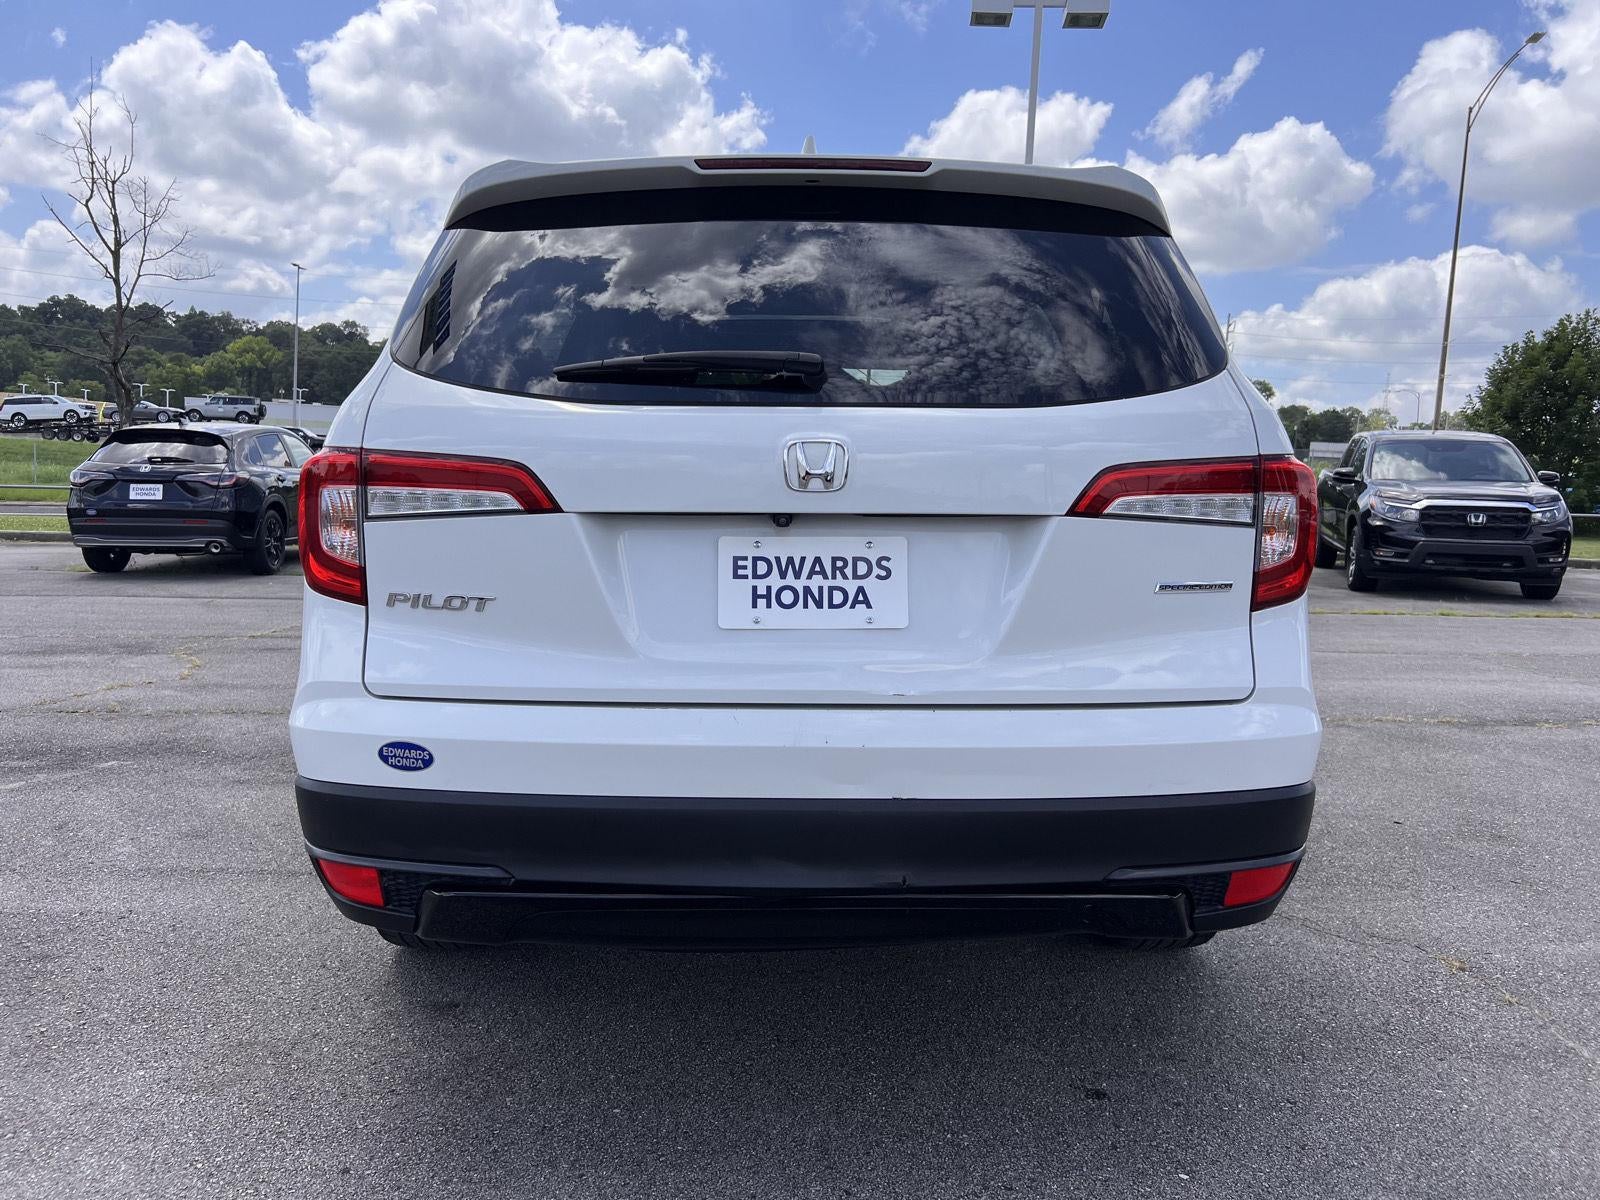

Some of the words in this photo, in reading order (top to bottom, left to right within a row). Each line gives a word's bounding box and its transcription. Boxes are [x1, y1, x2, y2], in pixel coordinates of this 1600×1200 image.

[732, 556, 892, 580] EDWARDS
[1199, 583, 1233, 591] EDITION
[386, 593, 497, 612] PILOT
[751, 585, 872, 609] HONDA
[383, 747, 429, 760] EDWARDS
[388, 757, 424, 768] HONDA
